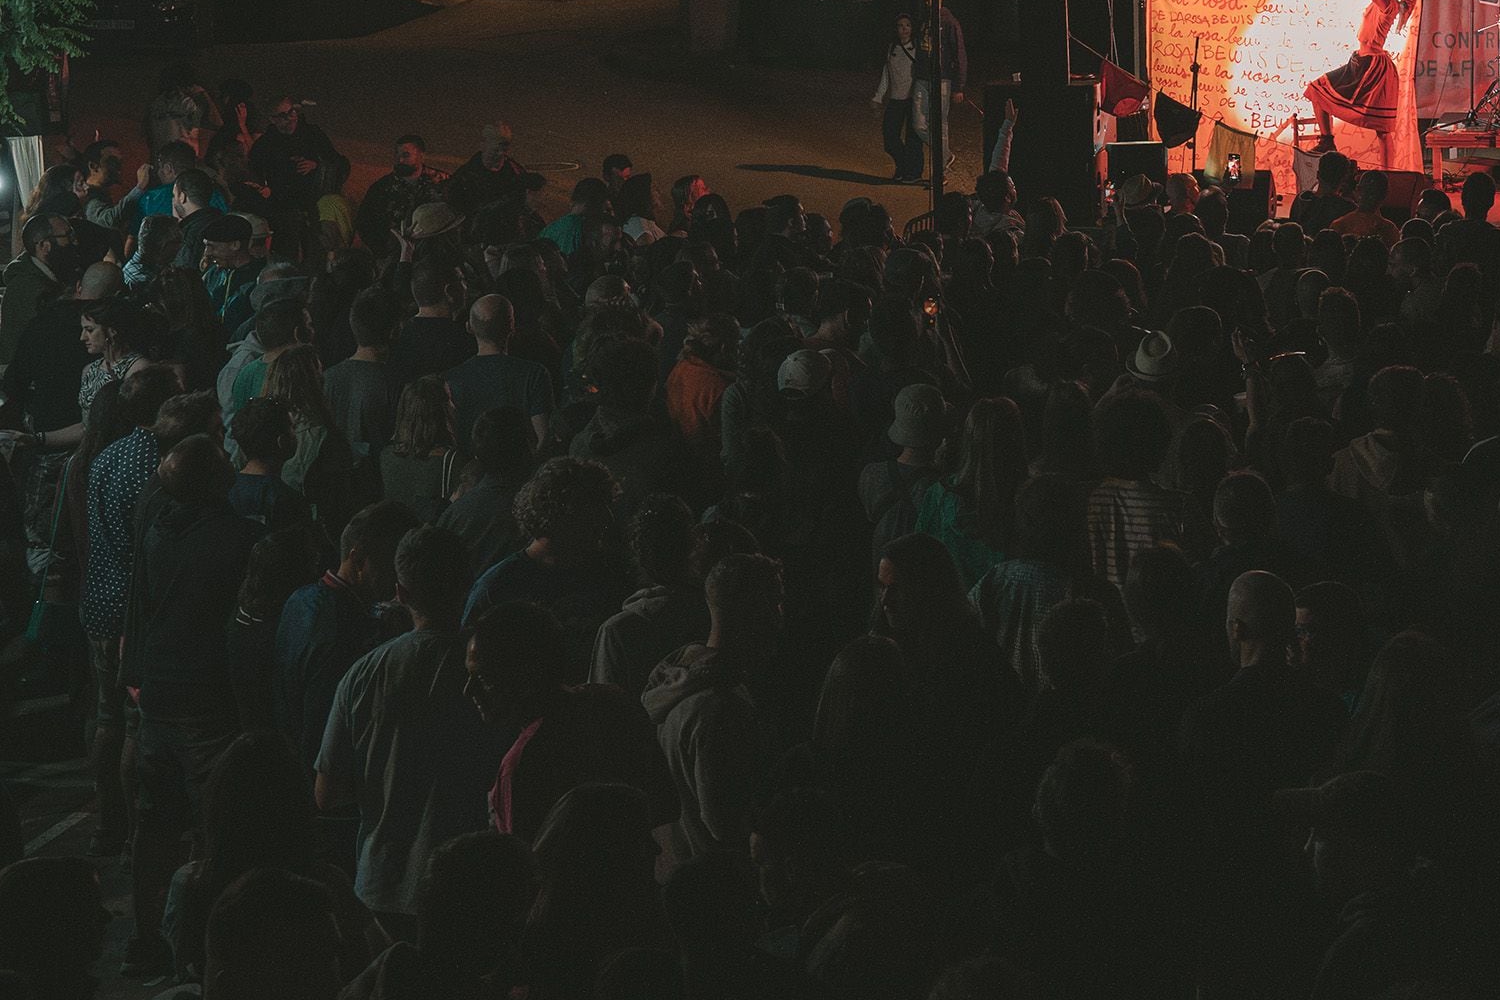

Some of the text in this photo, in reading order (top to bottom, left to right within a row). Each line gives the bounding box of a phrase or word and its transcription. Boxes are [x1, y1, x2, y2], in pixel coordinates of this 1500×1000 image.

[1168, 23, 1184, 38] la
[1153, 40, 1194, 62] ROSA
[1201, 45, 1267, 69] BEWIS
[1215, 64, 1234, 80] la
[1241, 69, 1286, 84] rosa
